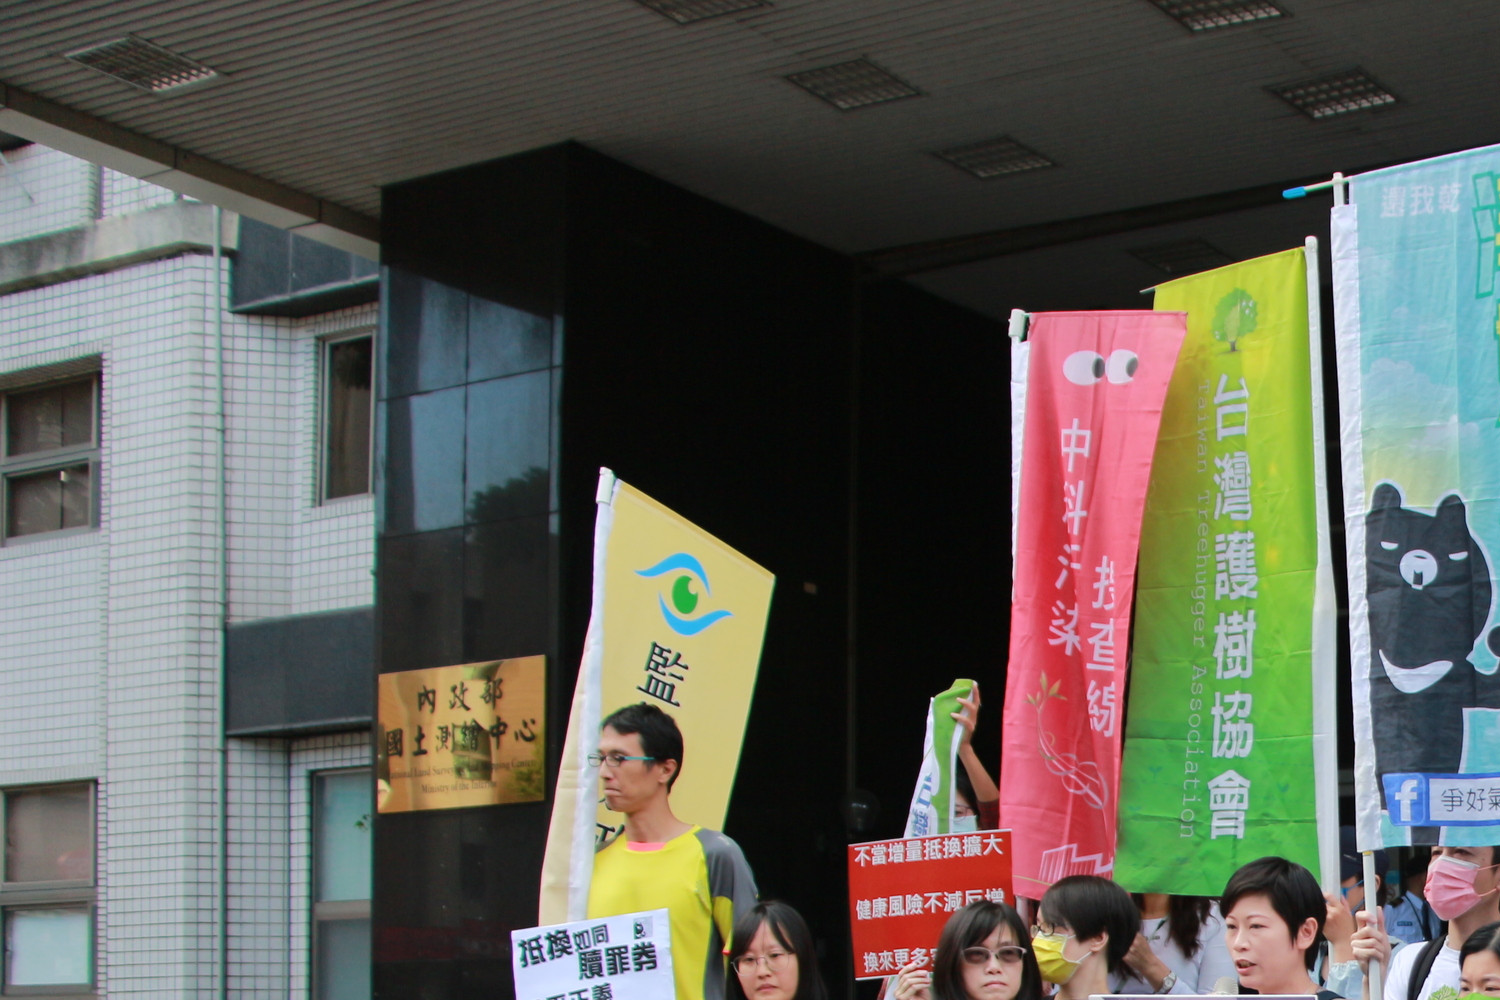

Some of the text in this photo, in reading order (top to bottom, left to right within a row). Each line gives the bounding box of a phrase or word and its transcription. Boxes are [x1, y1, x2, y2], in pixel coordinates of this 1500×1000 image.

[1180, 379, 1211, 838] Taiwan Treehugger Association
[1207, 373, 1258, 840] 台灣護樹協會
[636, 641, 689, 707] 監
[417, 677, 503, 713] 內政部
[386, 716, 537, 757] 國土測繪中心
[421, 784, 449, 794] Ministry
[459, 782, 469, 791] the
[854, 834, 1003, 867] 不當增量抵換擴大
[517, 923, 609, 968] 抵換如同
[578, 942, 658, 980] 贖罪券
